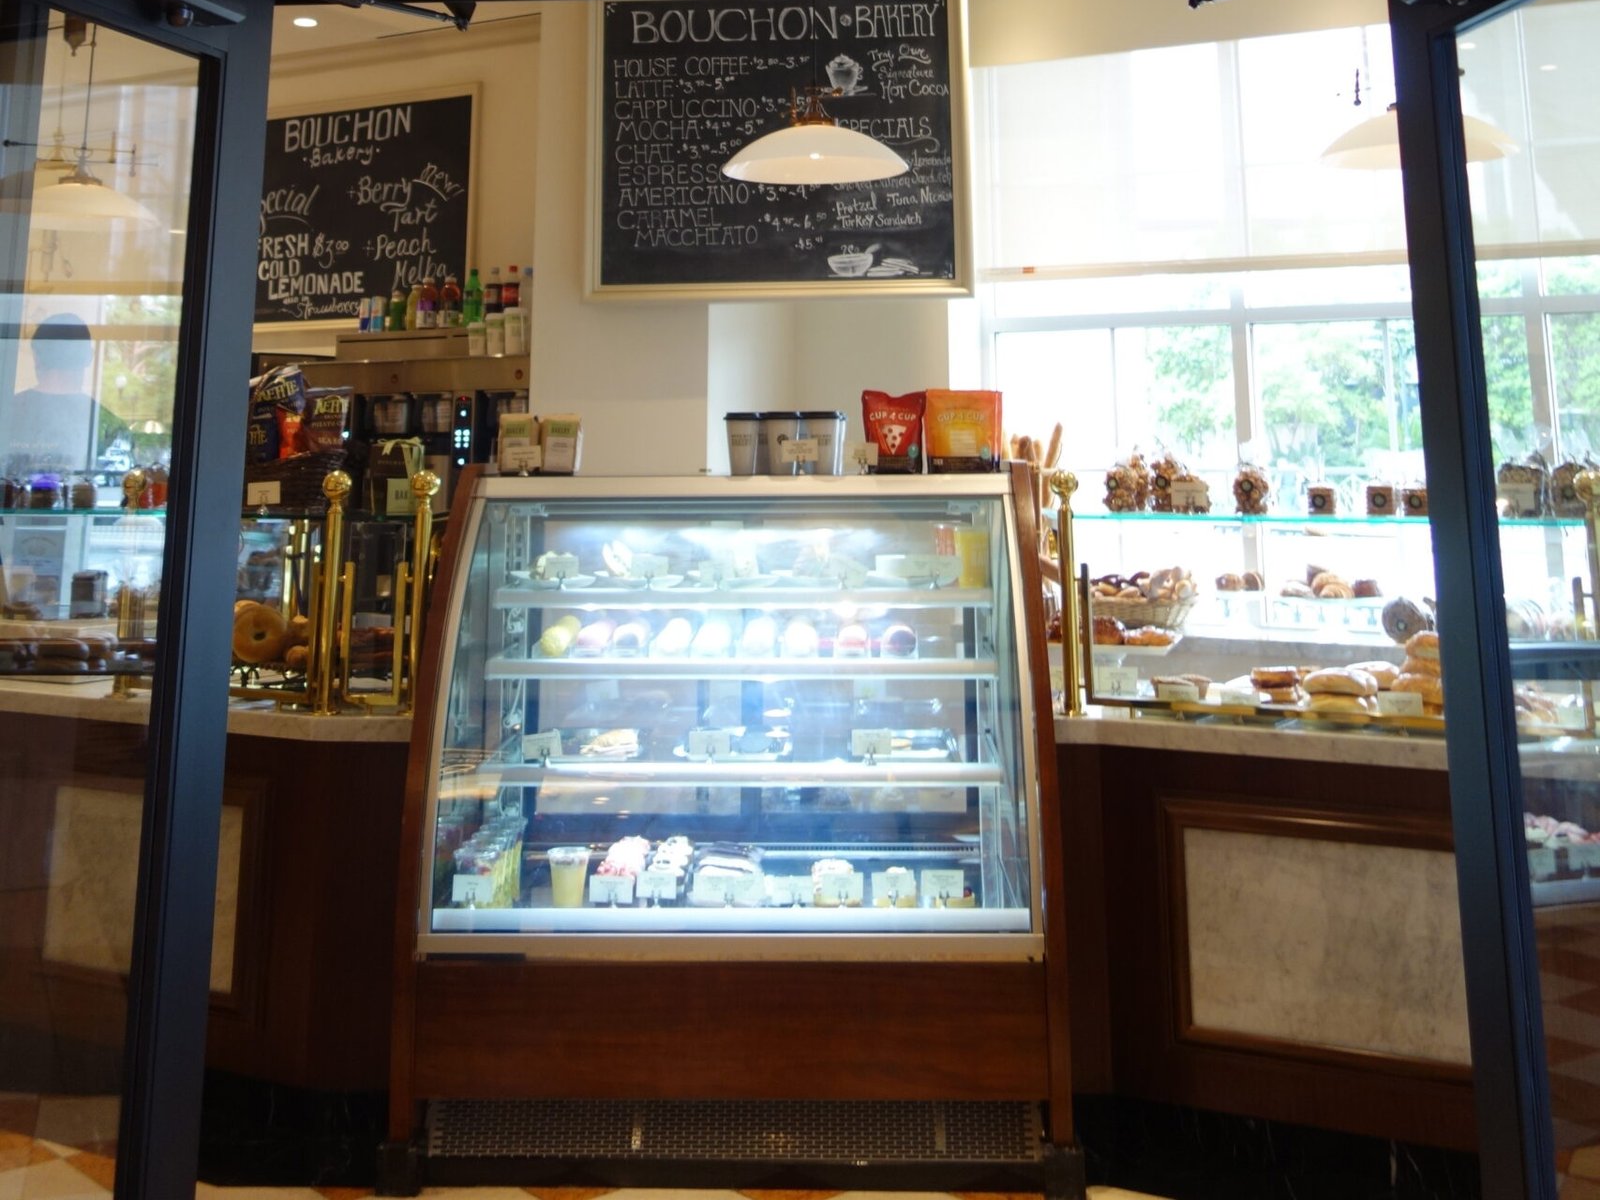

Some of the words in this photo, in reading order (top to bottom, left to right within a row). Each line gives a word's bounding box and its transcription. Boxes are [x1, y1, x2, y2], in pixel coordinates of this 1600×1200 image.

[631, 6, 839, 44] BOUCHON
[855, 3, 939, 39] BAKERY
[613, 57, 677, 78] HOUSE
[685, 56, 750, 77] COFFEE
[615, 79, 674, 98] LATTE
[614, 98, 757, 120] CAPPUCCINO
[284, 105, 412, 152] BOUCHON
[616, 120, 700, 141] MOCHA
[309, 145, 374, 168] Bakery
[615, 143, 675, 164] CHAI
[260, 184, 320, 216] pecial
[357, 176, 412, 205] Berry
[618, 183, 749, 207] AMERICANO
[388, 199, 438, 232] Tart
[617, 207, 722, 230] CARAMEL
[258, 233, 309, 259] RESH
[375, 227, 437, 260] Peach
[634, 225, 758, 247] MACCHIATO
[258, 259, 301, 281] COLD
[392, 256, 450, 289] Melba
[268, 271, 365, 301] LEMONADE
[869, 412, 887, 421] CUP
[889, 412, 896, 420] 4
[898, 412, 916, 421] CUP
